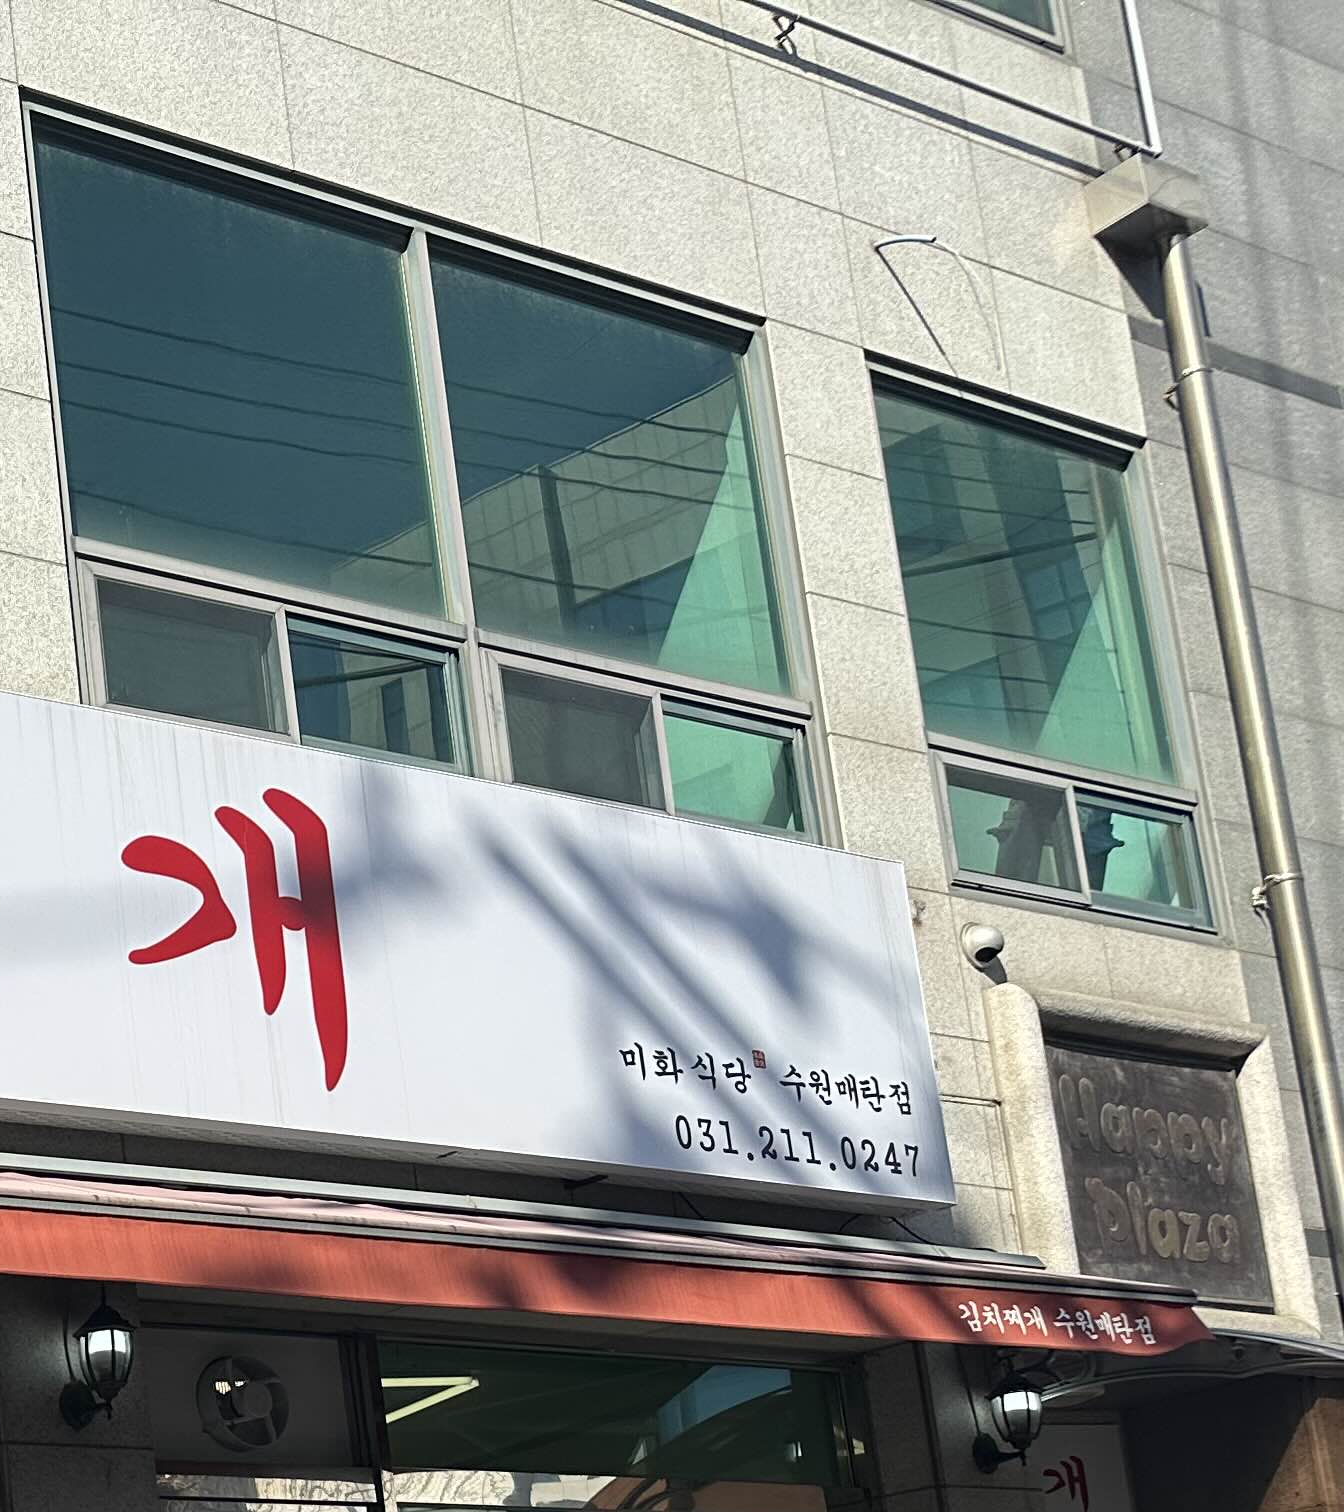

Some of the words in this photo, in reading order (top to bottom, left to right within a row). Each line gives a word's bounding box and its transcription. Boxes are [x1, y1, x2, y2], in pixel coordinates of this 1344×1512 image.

[618, 1041, 752, 1094] 미화식당
[779, 1064, 912, 1116] 수원매탄점
[675, 1114, 919, 1177] 031.211.0247
[958, 1300, 1049, 1337] 김치찌개
[1052, 1307, 1157, 1345] 수원매탄점
